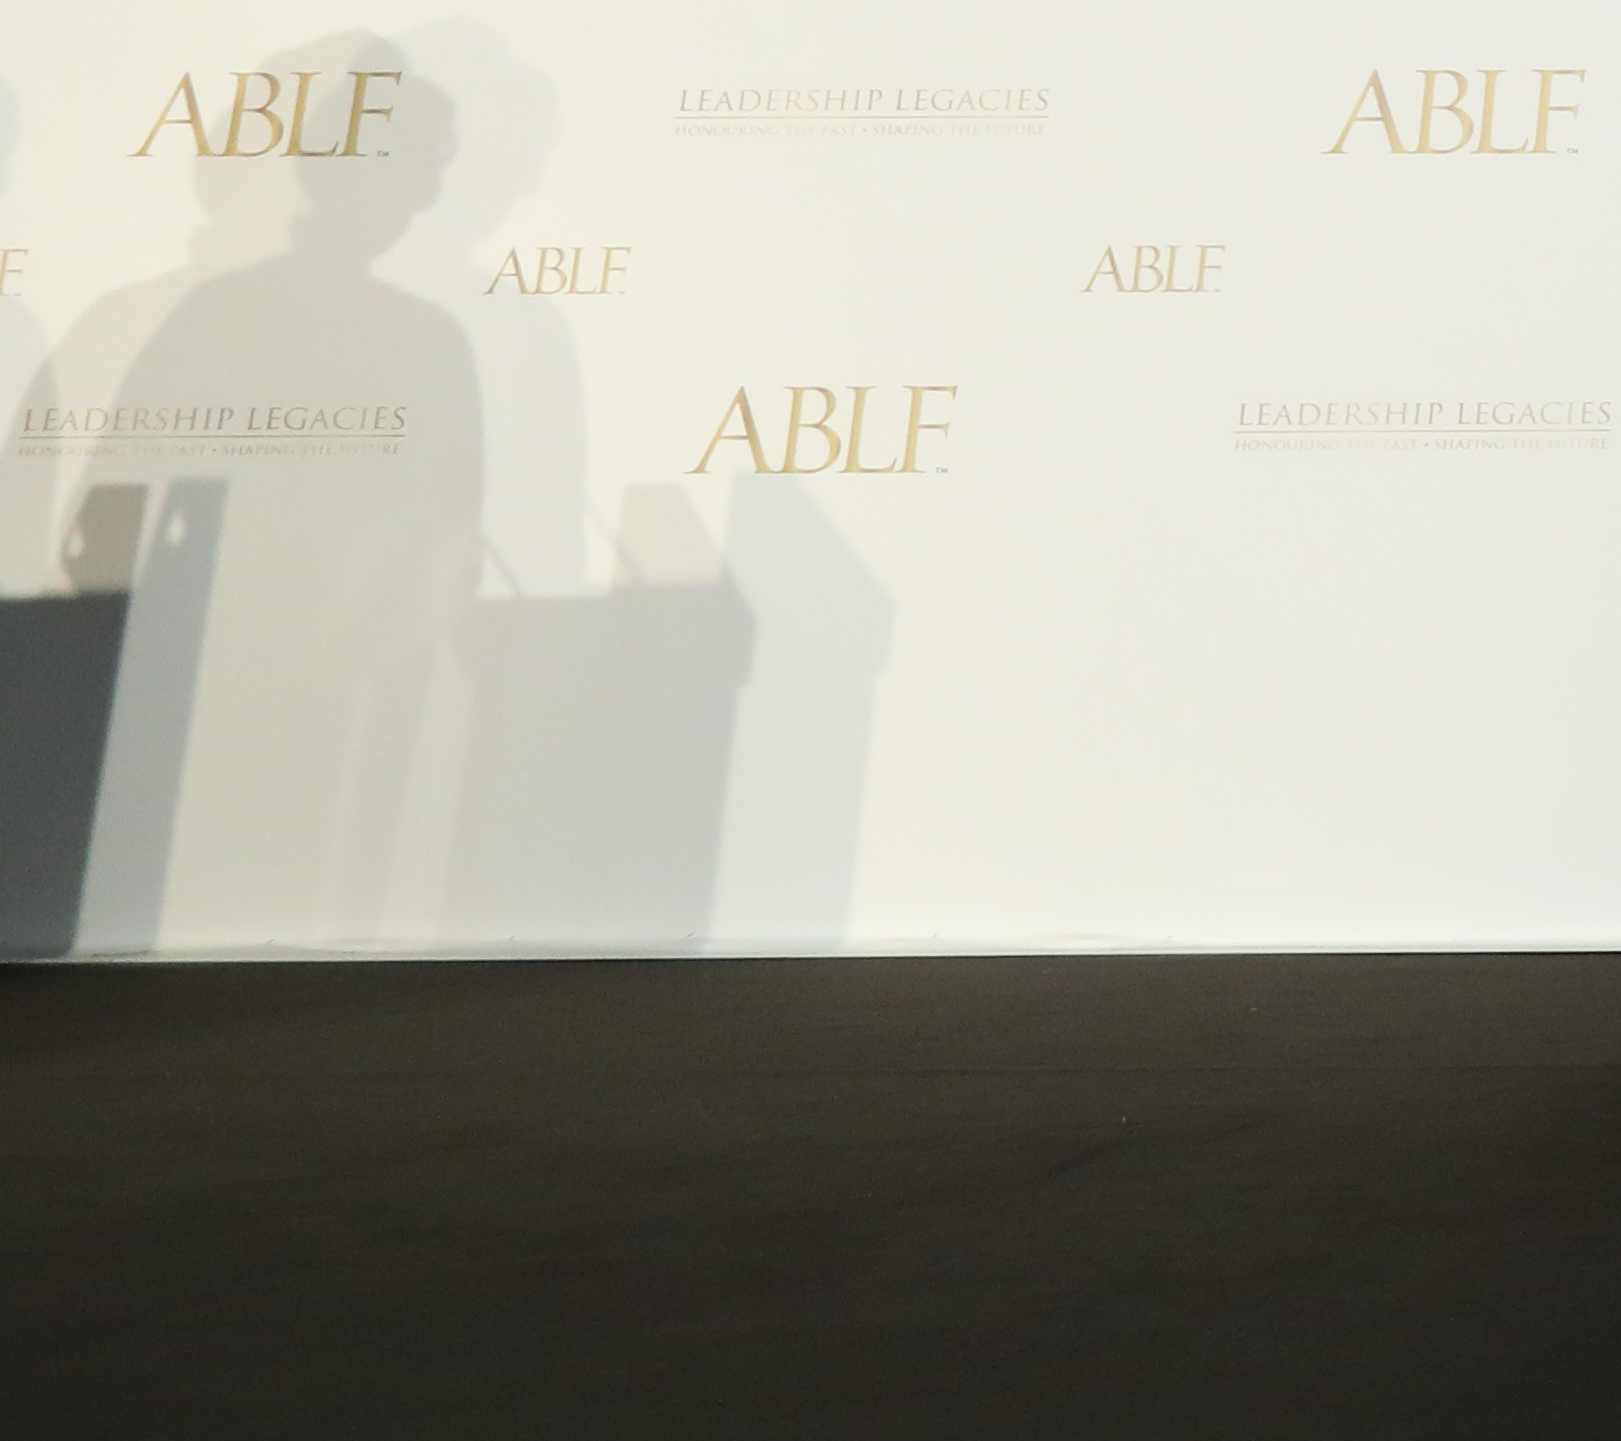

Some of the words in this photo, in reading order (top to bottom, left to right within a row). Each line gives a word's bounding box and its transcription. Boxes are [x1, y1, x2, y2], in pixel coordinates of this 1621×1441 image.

[127, 71, 402, 158] ABLF
[679, 89, 883, 112] LEADERSHIP
[895, 89, 1049, 111] LEGACIES
[1323, 69, 1586, 154] ABLF
[484, 247, 631, 295] ABLF
[1082, 245, 1226, 293] ABLF
[23, 407, 234, 431] LEADERSHIP
[247, 406, 407, 431] LEGACIES
[685, 385, 958, 474] ABLF
[1239, 402, 1443, 426] LEADERSHIP
[1457, 401, 1611, 425] LEGACIES
[1235, 439, 1340, 451] HONOURING
[1435, 439, 1505, 451] SHAPING
